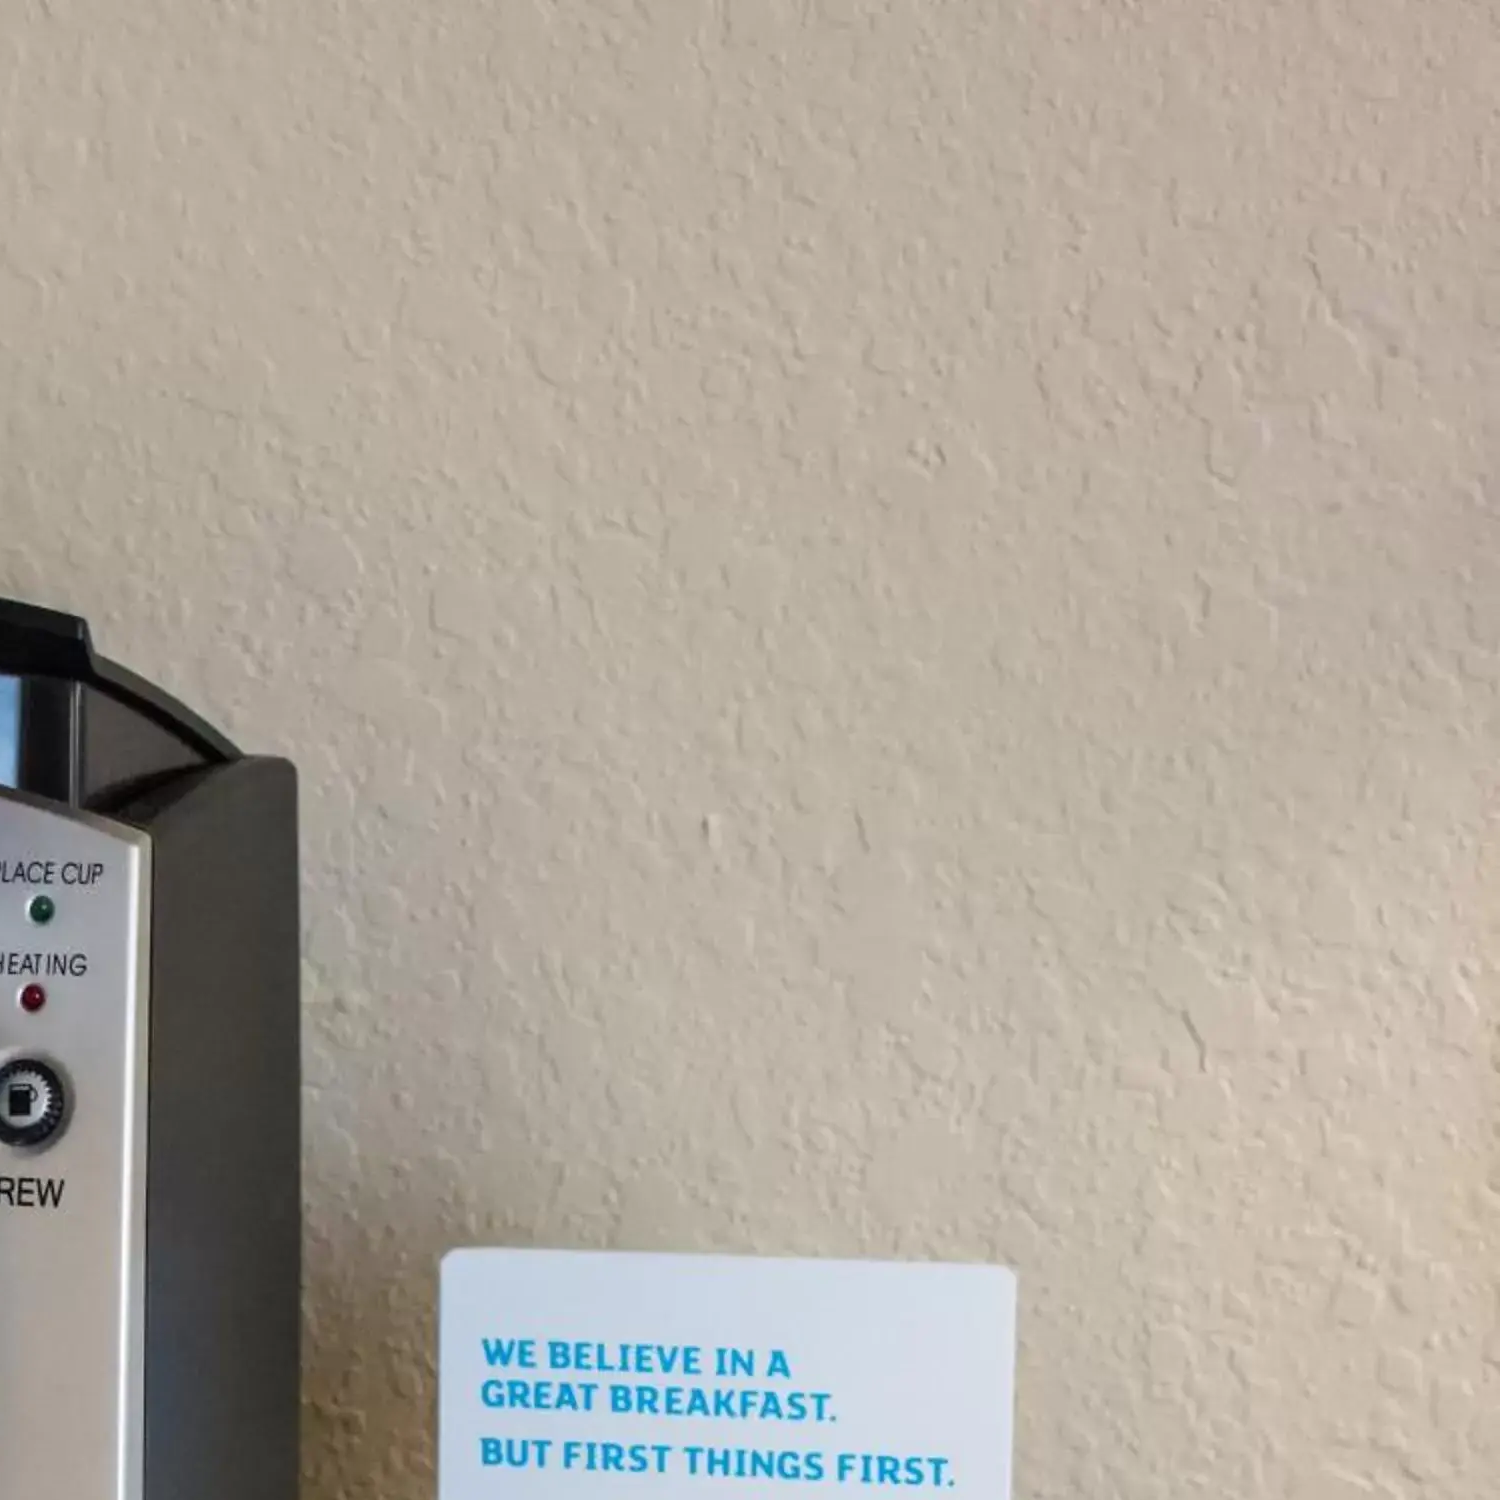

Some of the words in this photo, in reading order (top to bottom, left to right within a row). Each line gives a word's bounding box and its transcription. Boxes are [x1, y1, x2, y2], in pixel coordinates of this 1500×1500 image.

[61, 863, 105, 885] CUP
[481, 1338, 537, 1368] WE
[548, 1341, 702, 1375] BELIEVE
[716, 1348, 754, 1376] IN
[767, 1349, 791, 1379] A
[481, 1379, 598, 1411] GREAT
[609, 1384, 836, 1422] BREAKFAST.
[480, 1438, 552, 1468] BUT
[563, 1441, 672, 1474] FIRST
[683, 1446, 824, 1481] THINGS
[838, 1454, 955, 1486] FIRST.
